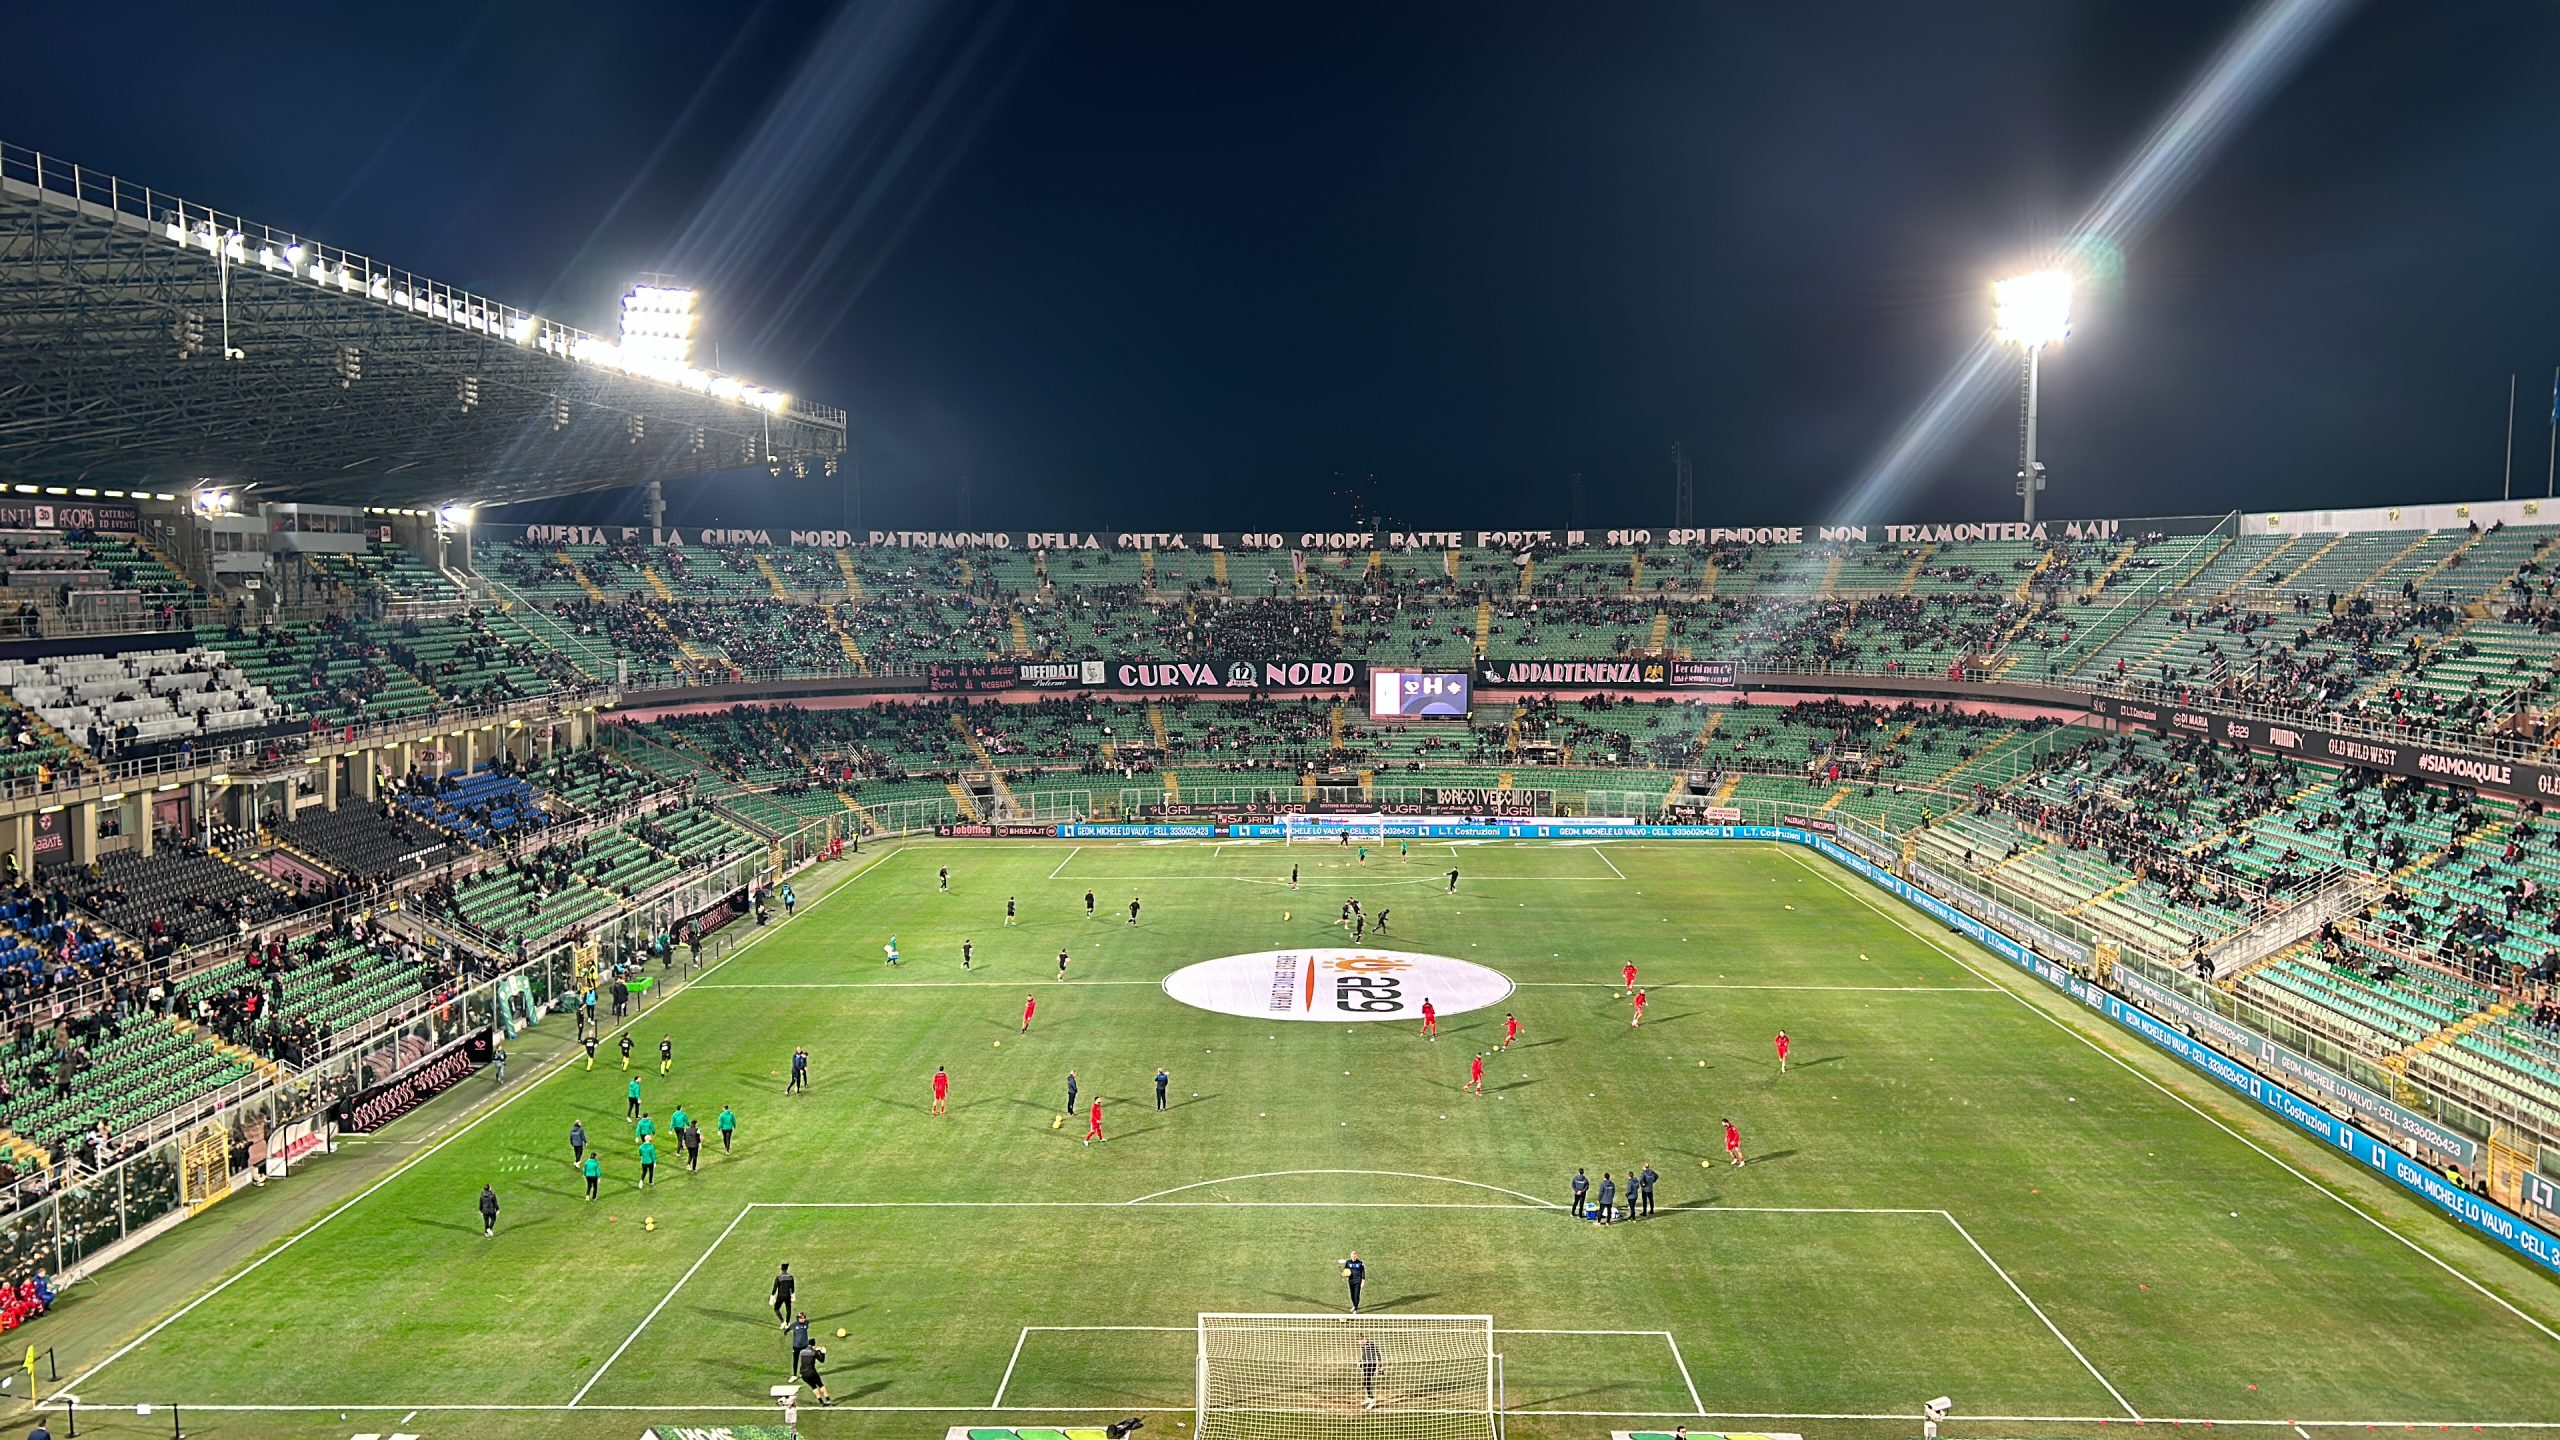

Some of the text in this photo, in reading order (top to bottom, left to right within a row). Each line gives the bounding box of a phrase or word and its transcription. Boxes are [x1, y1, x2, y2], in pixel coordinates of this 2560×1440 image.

[100, 510, 135, 519] CATERING
[111, 520, 136, 529] EVENTI
[527, 525, 607, 545] QUESTA
[653, 528, 684, 545] LA
[701, 529, 772, 546] CURVA
[869, 531, 1009, 548] PATRIMONIO
[1027, 533, 1100, 549] DELLA
[1203, 534, 1224, 548] IL
[1241, 533, 1283, 548] SUO
[1608, 530, 1650, 546] SUO
[1819, 526, 1866, 542] NON
[959, 666, 968, 676] di
[1020, 664, 1078, 679] DIFFIDATI
[1118, 662, 1354, 687] CURVA 12 NORD
[1508, 663, 1640, 683] APPARTENENZA
[965, 679, 973, 689] di
[2181, 713, 2208, 728] DI MARIA
[2270, 727, 2295, 748] PUMA
[2328, 738, 2397, 766] OLD WILD WEST
[2418, 753, 2512, 785] #SIAMOAQUILE
[1439, 789, 1533, 805] BORGO VECCHIO
[1158, 806, 1190, 815] UGRI
[1273, 804, 1306, 813] UGRI
[1388, 805, 1421, 814] UGRI
[1501, 806, 1532, 815] UGRI
[1784, 816, 1806, 827] PALERMO
[953, 825, 991, 835] JobOffice
[1097, 827, 1121, 835] MICHELE
[1122, 827, 1130, 835] LO
[1131, 827, 1149, 835] VALVO
[1170, 827, 1208, 835] 3336026423
[1455, 827, 1500, 836] Costruzioni
[1672, 828, 1718, 836] 3336026423
[1760, 829, 1800, 840] Costruzioni
[2035, 960, 2049, 978] Serie
[2070, 980, 2085, 998] Serie
[2143, 986, 2164, 1004] MICHELE
[2172, 1000, 2189, 1015] VALVO
[2209, 1021, 2249, 1047] 3336026423
[2141, 1020, 2163, 1041] MICHELE
[2164, 1033, 2171, 1046] LO
[2172, 1037, 2188, 1056] VALVO
[2208, 1058, 2248, 1089] 3336026423
[2268, 1089, 2331, 1137] L.T. Costruzioni
[2281, 1056, 2302, 1077] GEOM.
[2304, 1068, 2336, 1093] MICHELE
[2336, 1083, 2347, 1098] LO
[2347, 1088, 2372, 1111] VALVO
[2402, 1117, 2461, 1156] 3336026423
[2397, 1162, 2423, 1190] GEOM.
[2425, 1179, 2465, 1215] MICHELE
[2465, 1200, 2479, 1222] LO
[2480, 1209, 2513, 1240] VALVO
